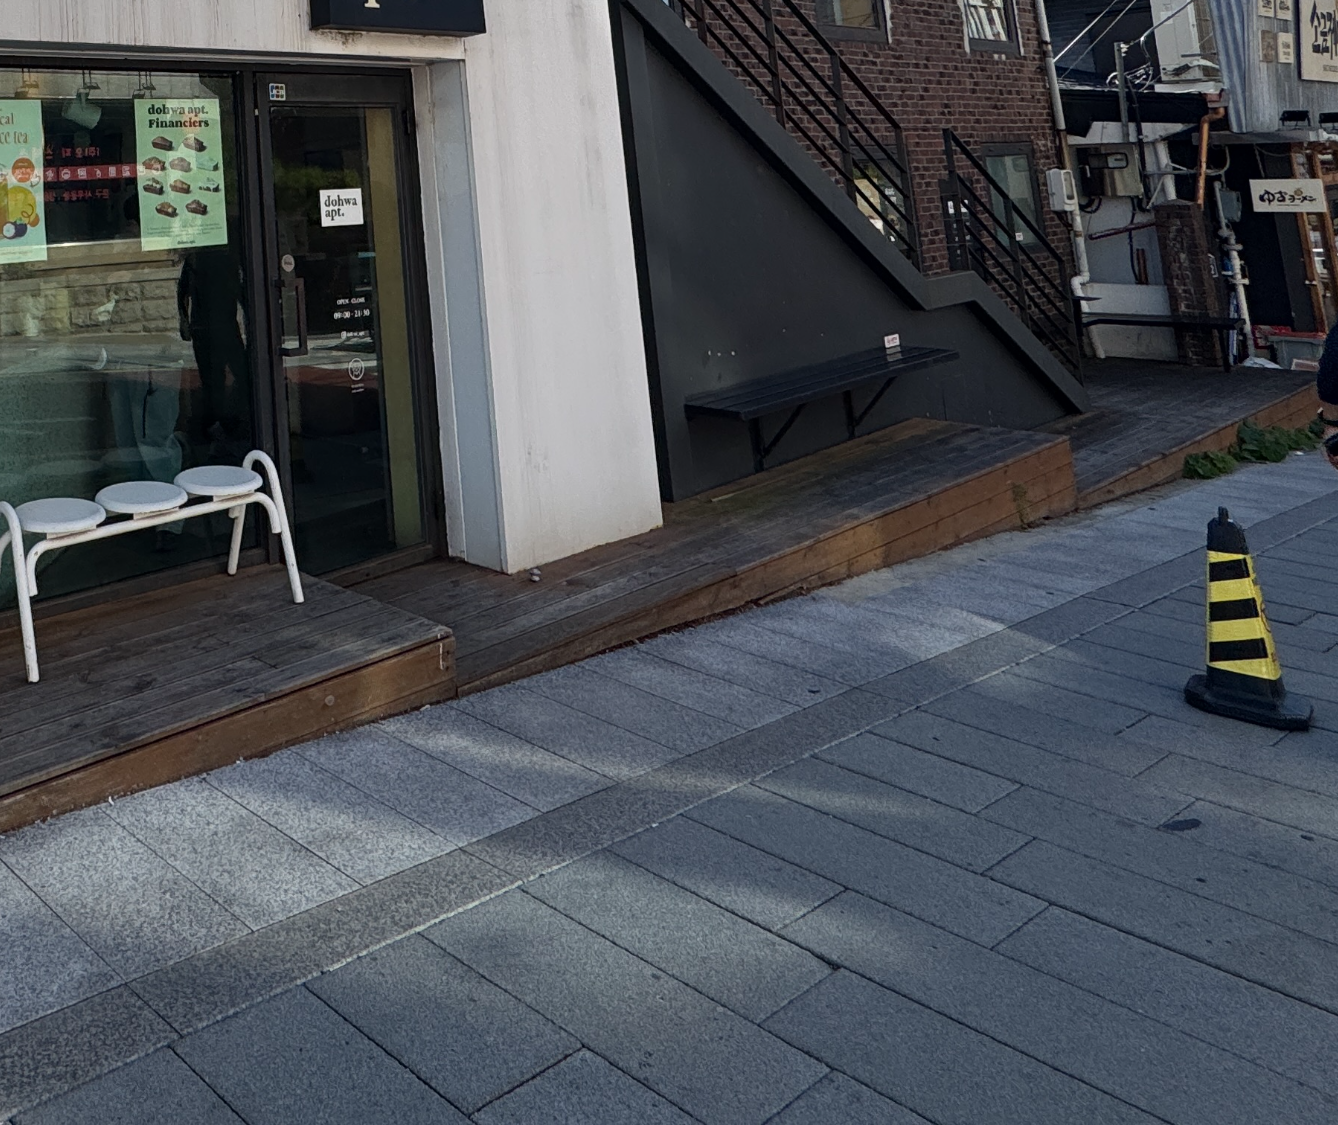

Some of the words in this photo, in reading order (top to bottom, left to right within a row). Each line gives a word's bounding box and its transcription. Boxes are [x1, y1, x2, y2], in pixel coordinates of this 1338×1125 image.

[147, 104, 185, 115] dohwa
[187, 104, 209, 118] apt.
[148, 118, 210, 129] Financiers
[14, 130, 29, 144] tea
[324, 194, 358, 207] dohwa
[325, 208, 345, 221] apt.
[336, 298, 350, 306] OPEN
